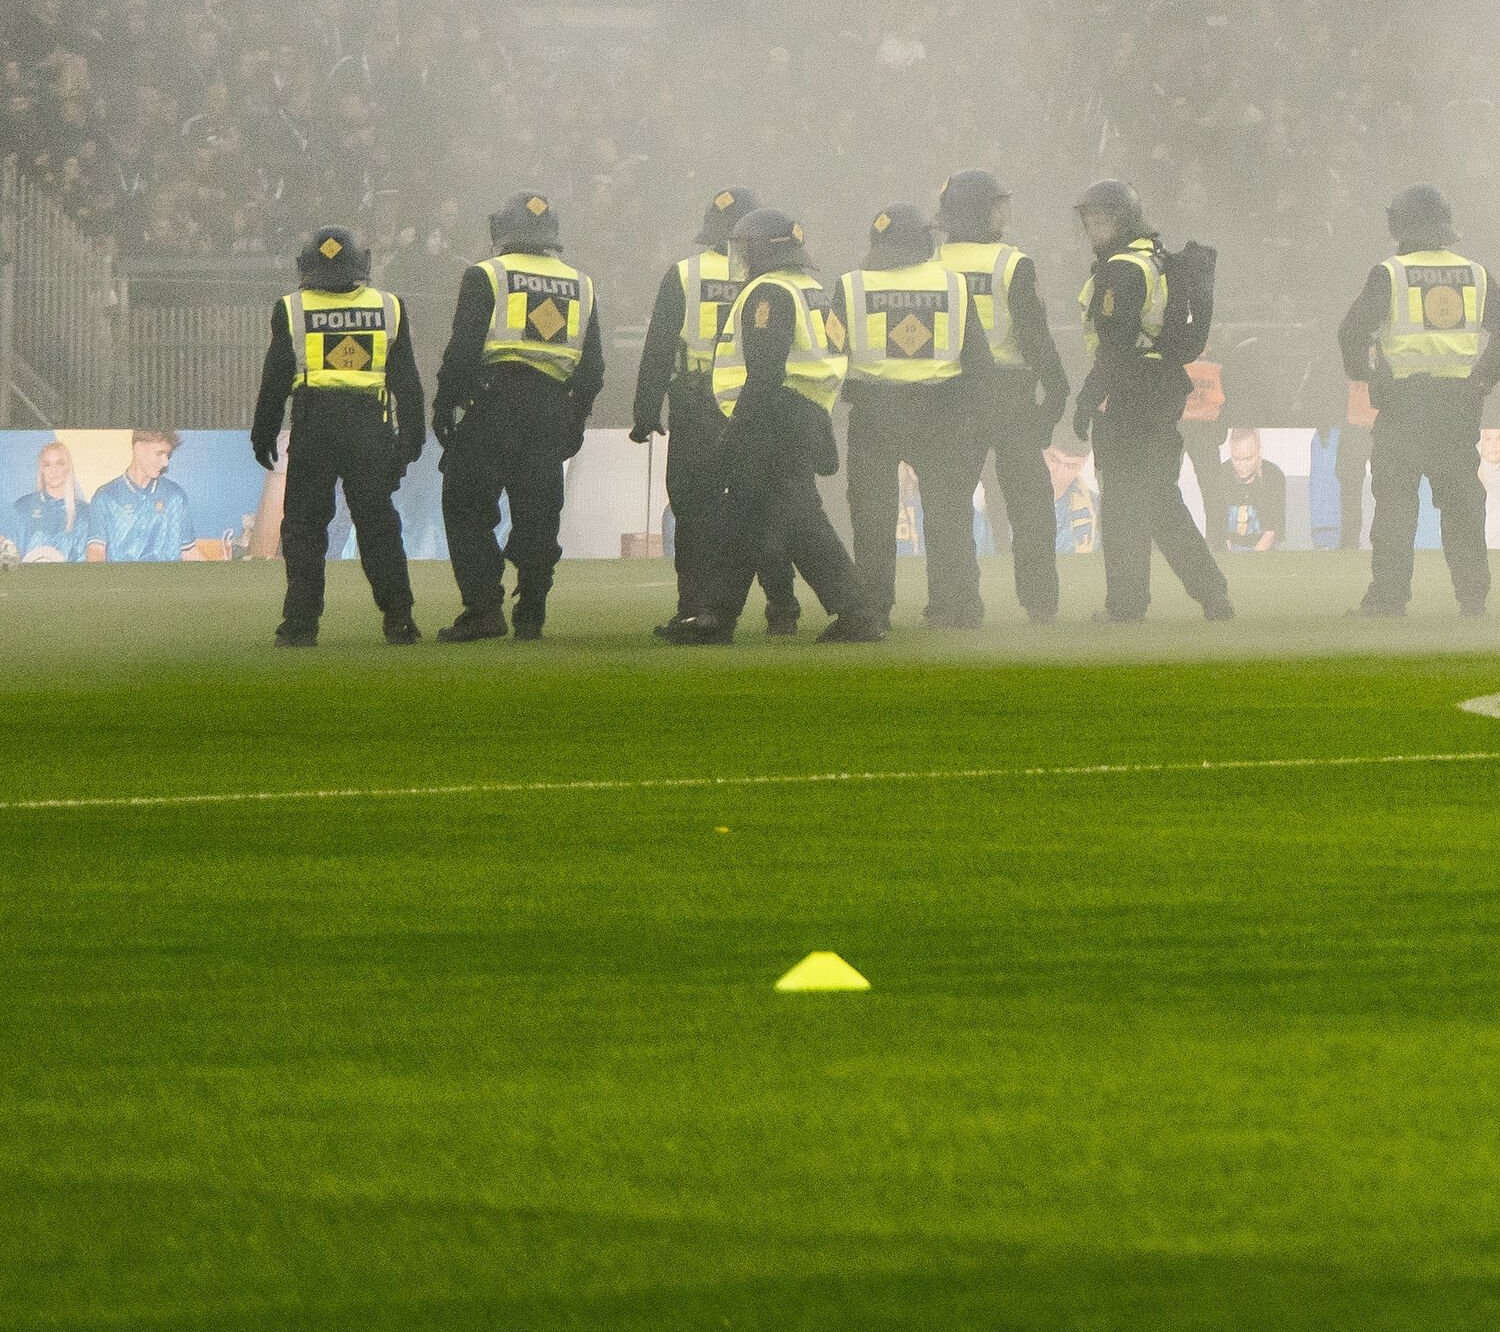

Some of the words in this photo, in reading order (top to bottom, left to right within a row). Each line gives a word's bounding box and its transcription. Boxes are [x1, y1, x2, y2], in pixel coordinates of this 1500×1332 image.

[513, 274, 576, 295] POLITI
[873, 293, 943, 310] POLITI
[312, 311, 382, 328] POLITI
